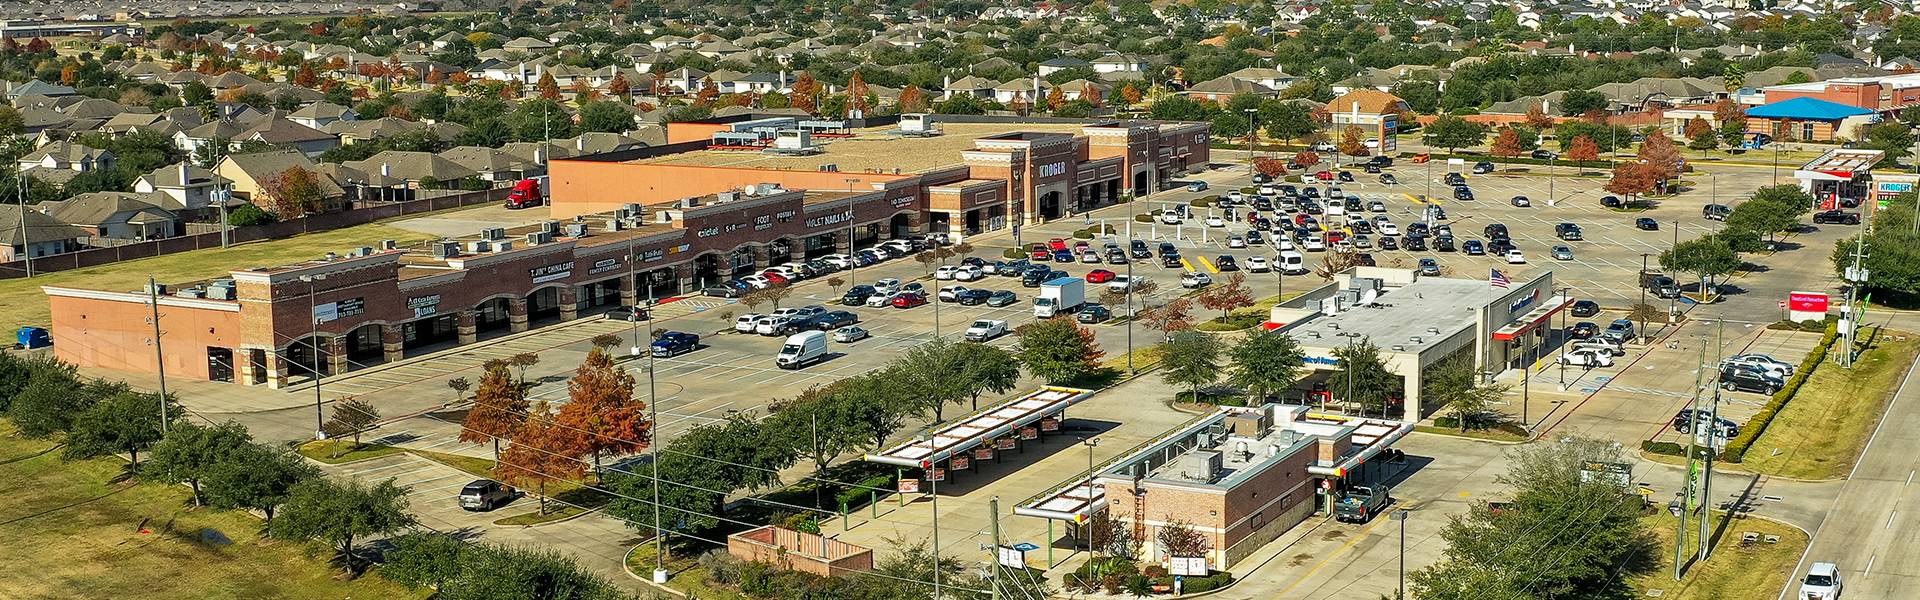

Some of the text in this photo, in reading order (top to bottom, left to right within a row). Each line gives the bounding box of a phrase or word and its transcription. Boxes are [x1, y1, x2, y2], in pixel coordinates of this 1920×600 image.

[1040, 161, 1066, 178] KROGER
[1880, 183, 1911, 191] KROGER
[825, 214, 840, 225] NAILS
[547, 263, 562, 274] CHINA
[562, 261, 575, 272] CAFE
[420, 305, 436, 316] LOANS
